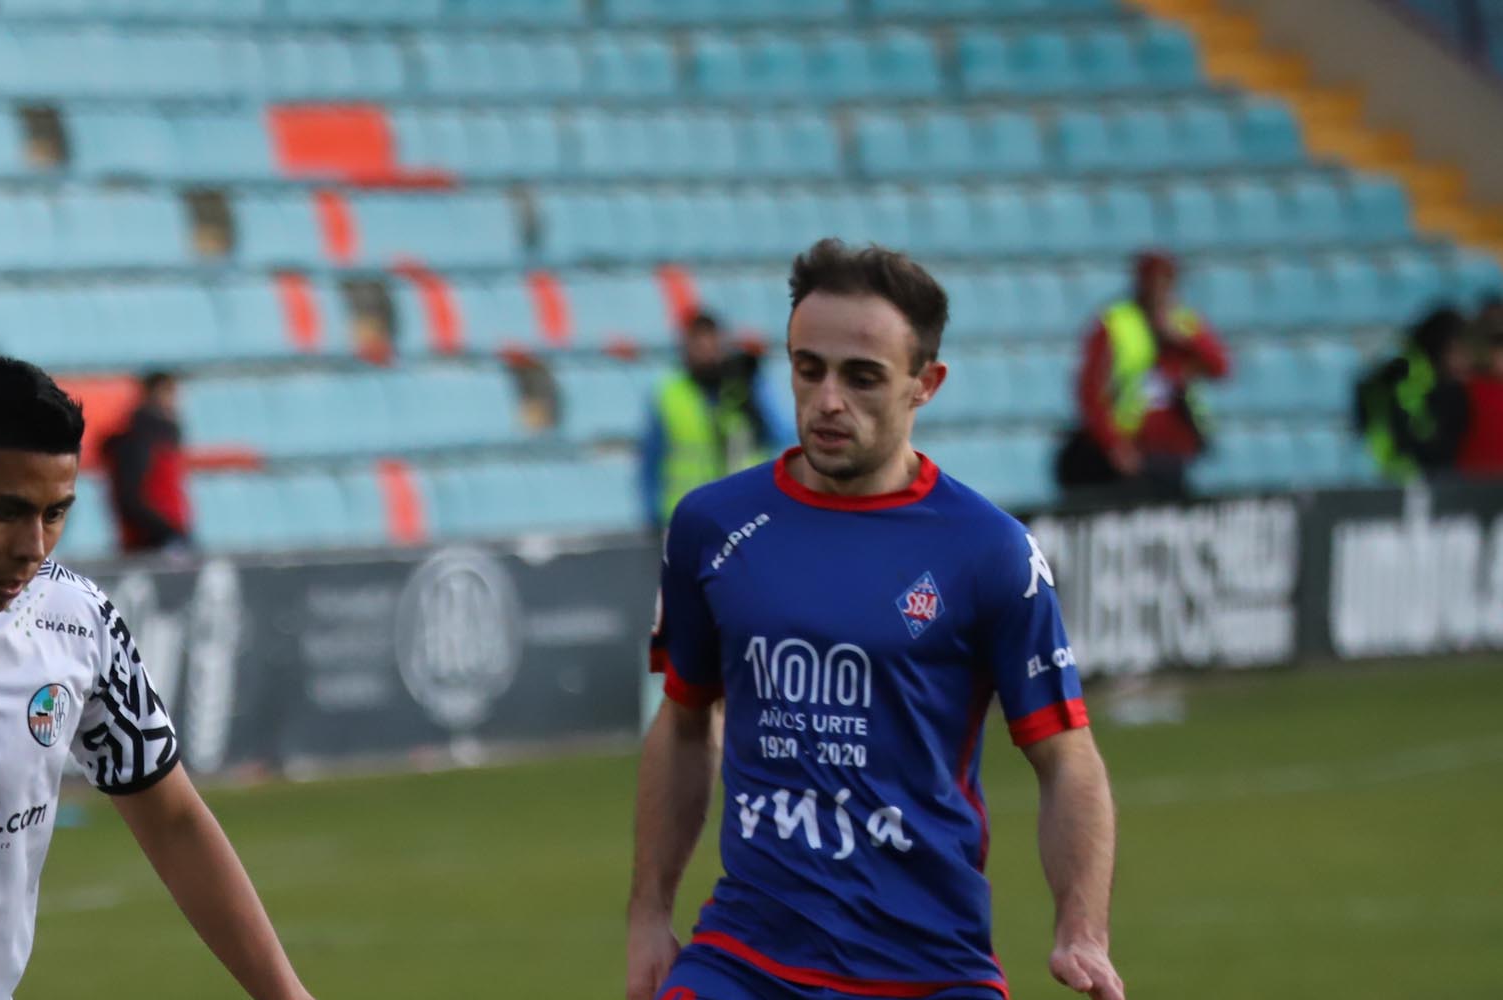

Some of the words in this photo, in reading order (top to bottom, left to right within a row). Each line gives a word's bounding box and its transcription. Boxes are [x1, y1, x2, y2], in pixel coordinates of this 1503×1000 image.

[711, 513, 770, 570] kappa
[35, 619, 95, 639] CHARRA
[744, 636, 872, 708] 100
[1027, 654, 1050, 678] EL
[758, 706, 807, 731] AÑOS
[812, 714, 868, 736] URTE
[817, 742, 867, 768] 2020
